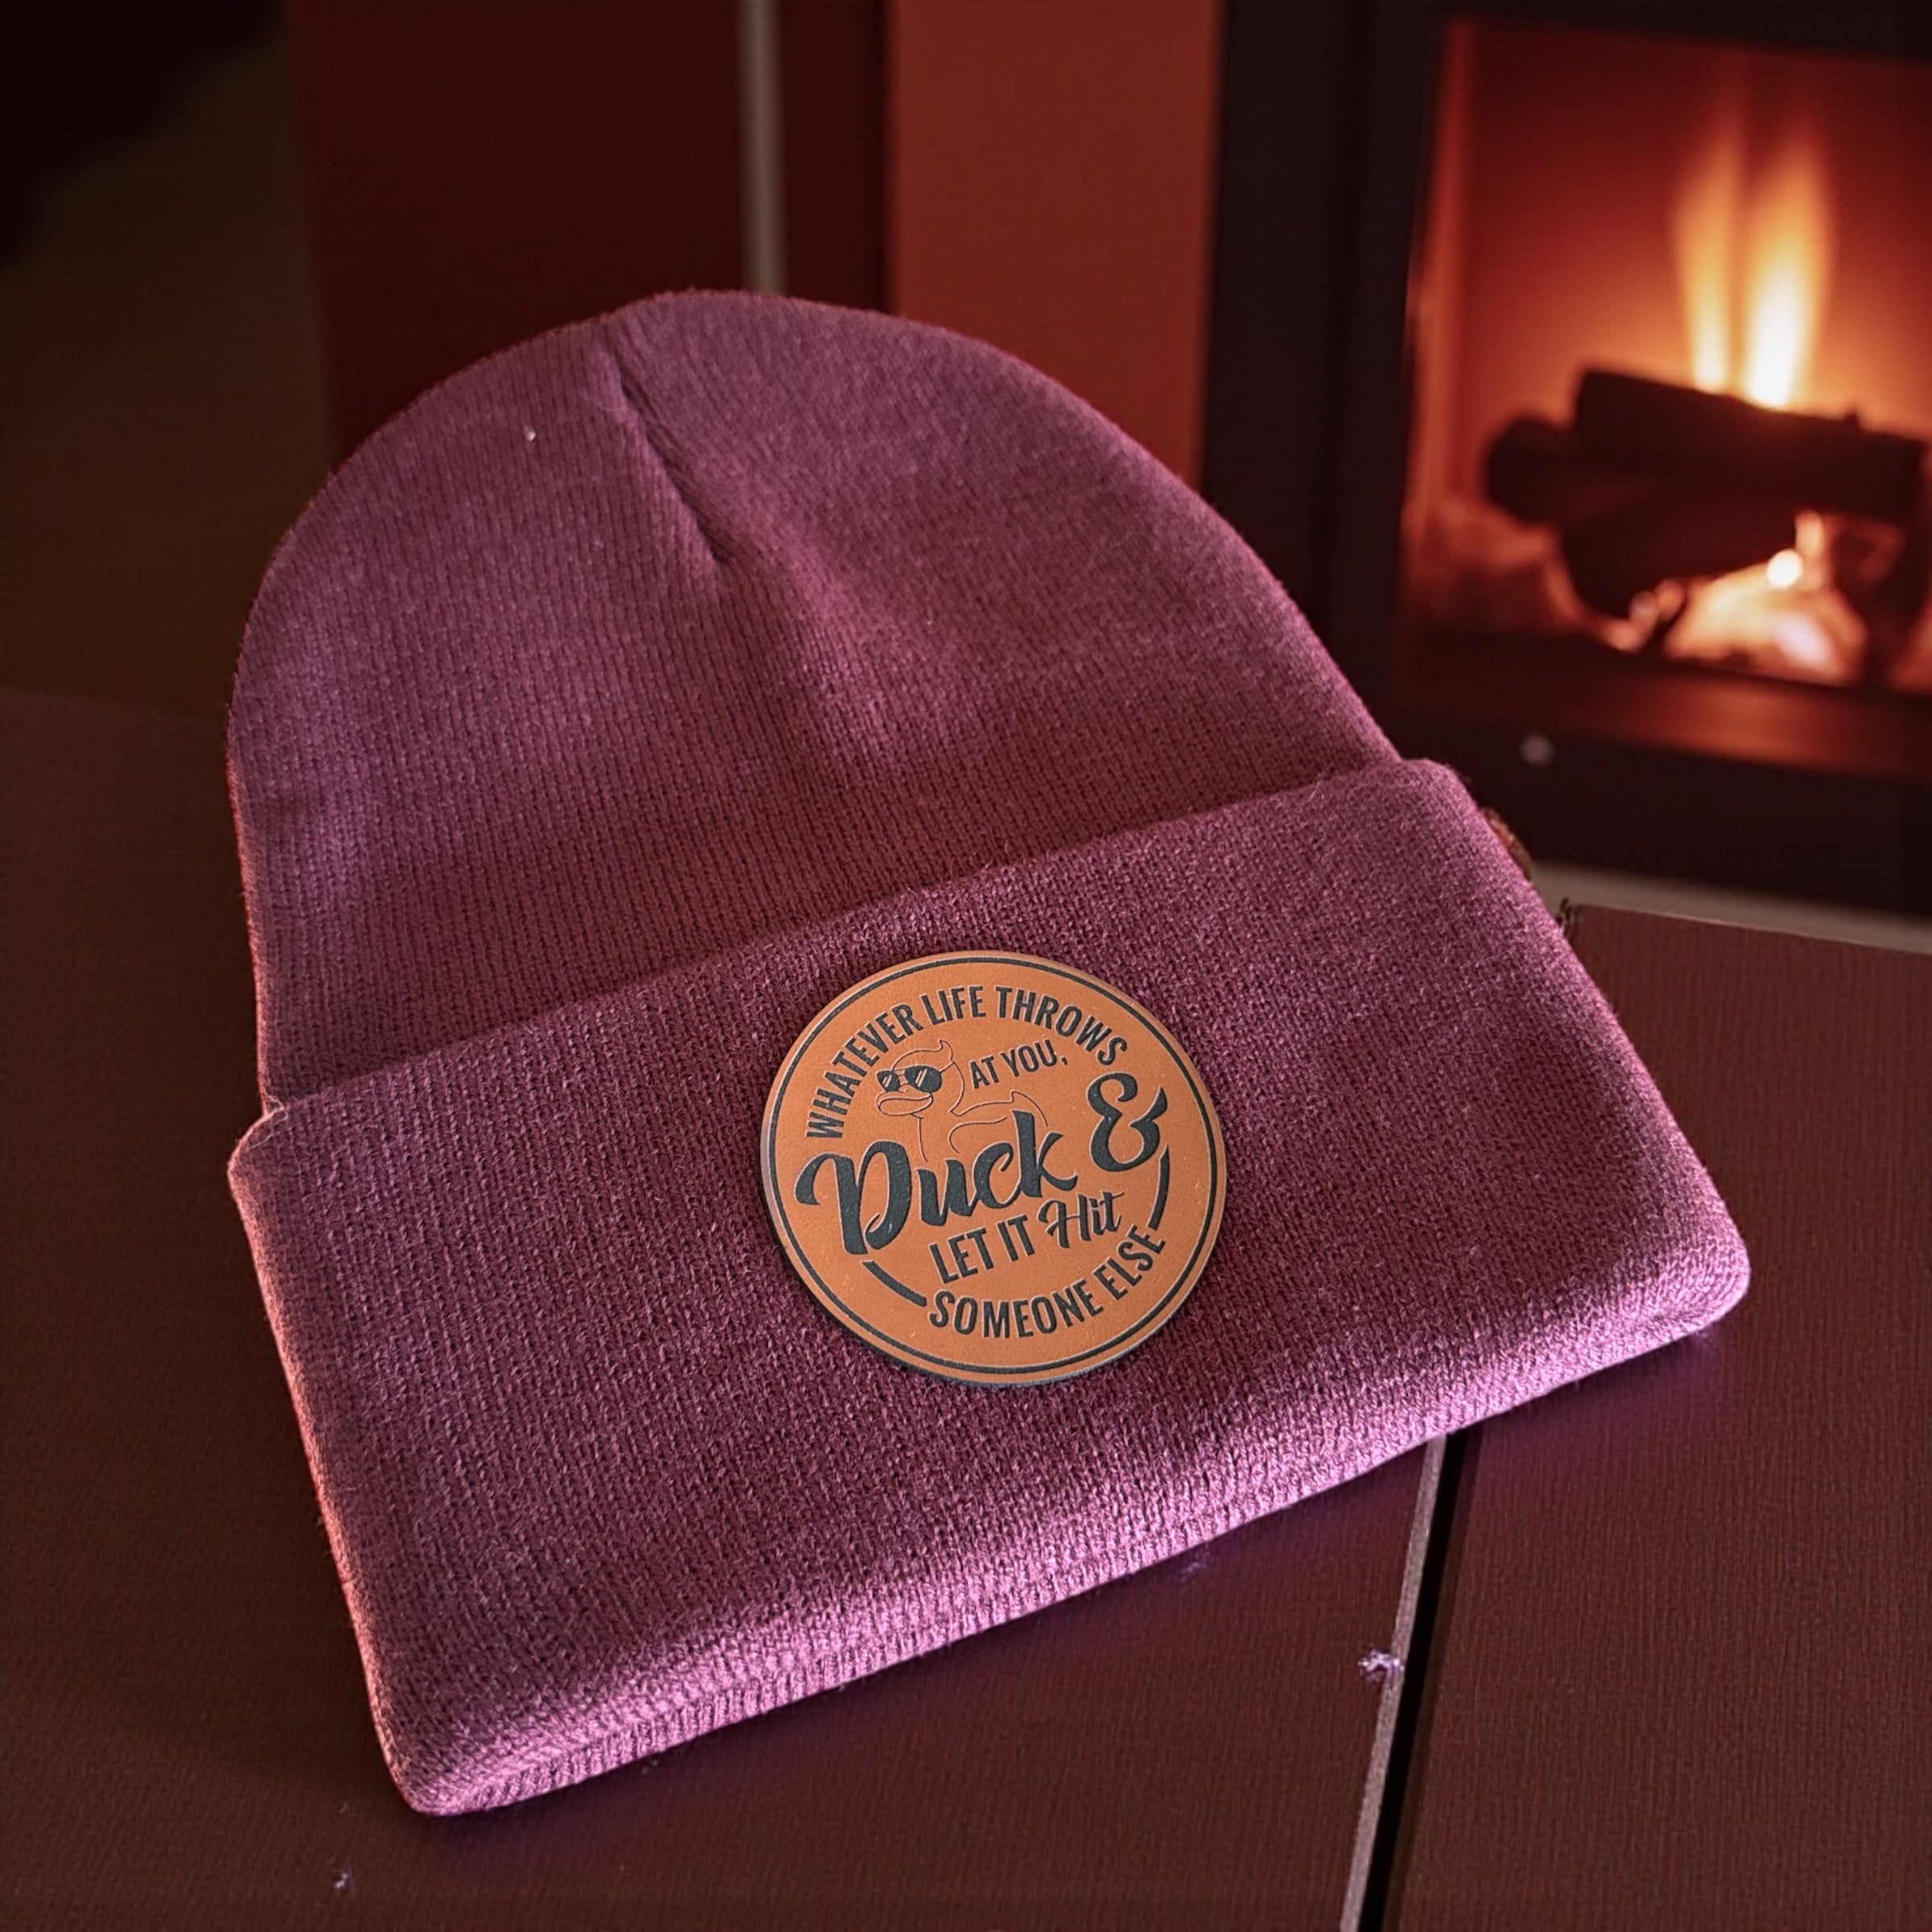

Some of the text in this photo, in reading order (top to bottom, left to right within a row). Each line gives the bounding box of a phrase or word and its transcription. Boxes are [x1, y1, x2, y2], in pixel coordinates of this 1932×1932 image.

[806, 986, 1128, 1138] WHATEVER LIFE THROWS
[971, 1040, 1067, 1088] AT YOU,
[795, 1072, 1168, 1254] Duck &
[929, 1191, 1124, 1283] LET IT Hit
[929, 1224, 1166, 1338] SOMEONE ELSE
